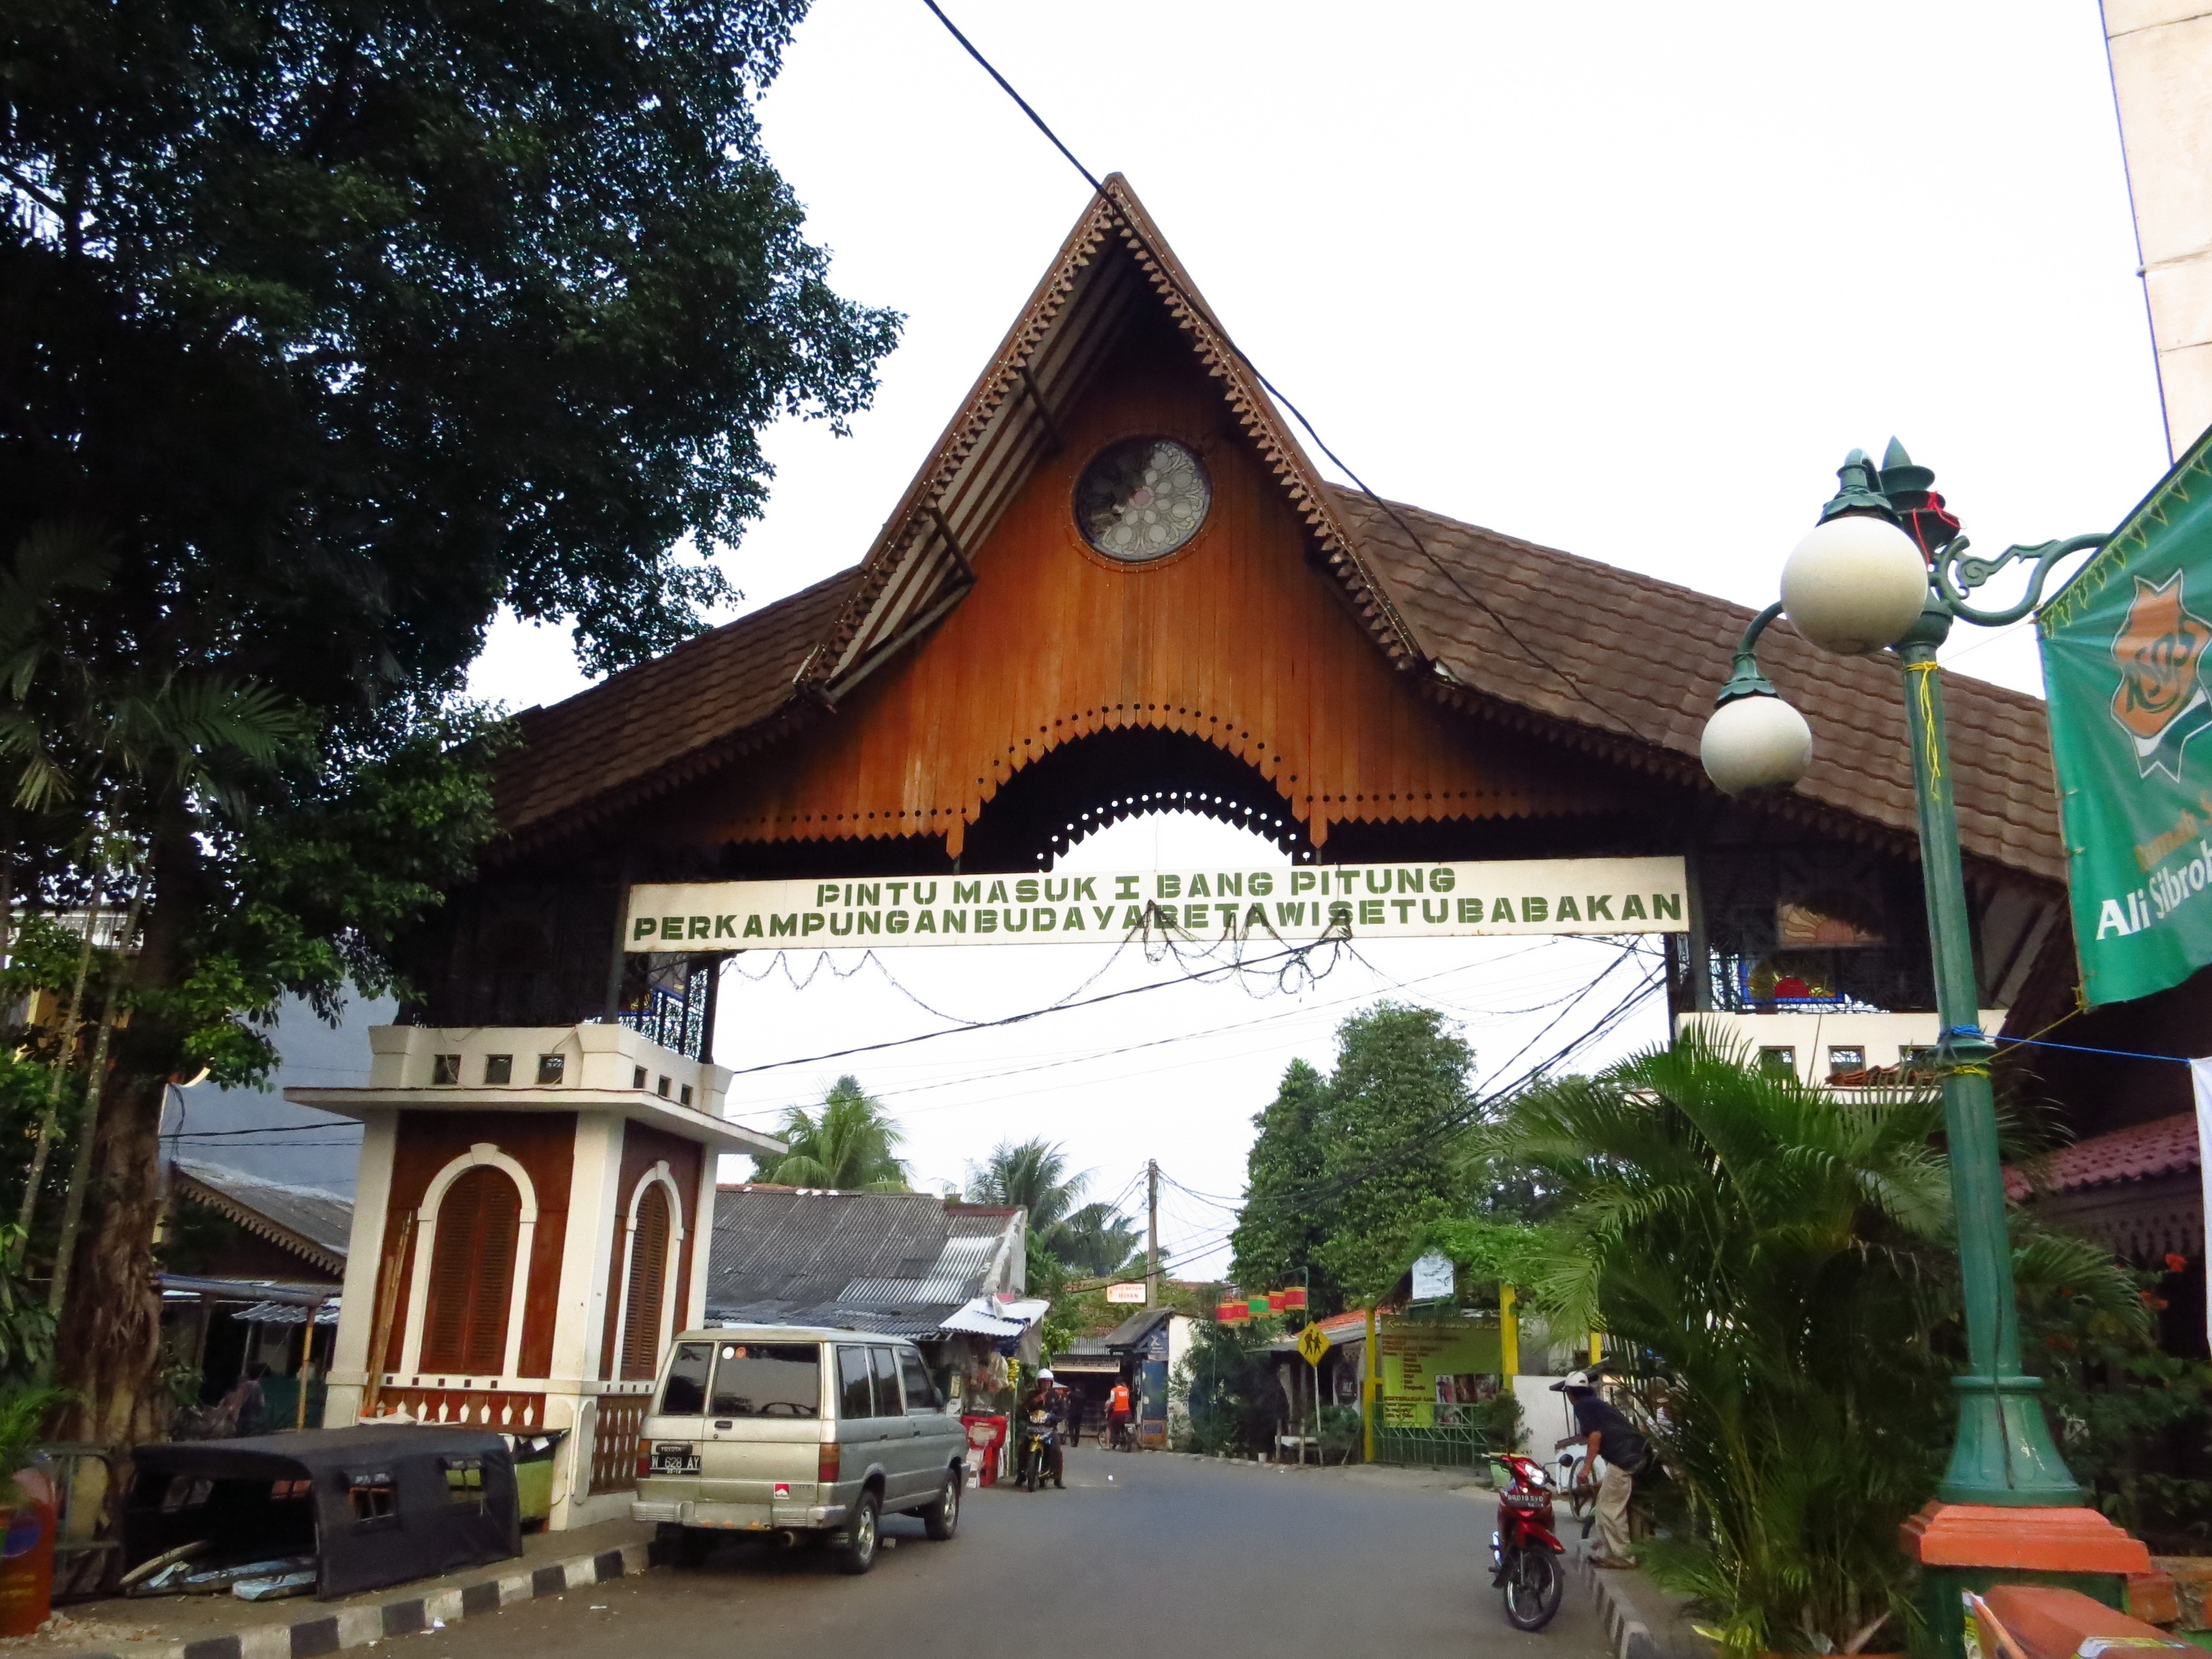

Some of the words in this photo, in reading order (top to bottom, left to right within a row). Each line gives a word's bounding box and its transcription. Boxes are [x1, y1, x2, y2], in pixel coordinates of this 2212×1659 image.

[817, 881, 936, 907] PINTU
[953, 876, 1097, 904] MASUK
[1115, 875, 1139, 900] I
[1157, 872, 1273, 898] BANG
[1291, 868, 1456, 896] PITUNG
[2096, 888, 2150, 940] Ali
[665, 1457, 682, 1468] 628
[687, 1456, 700, 1470] AY
